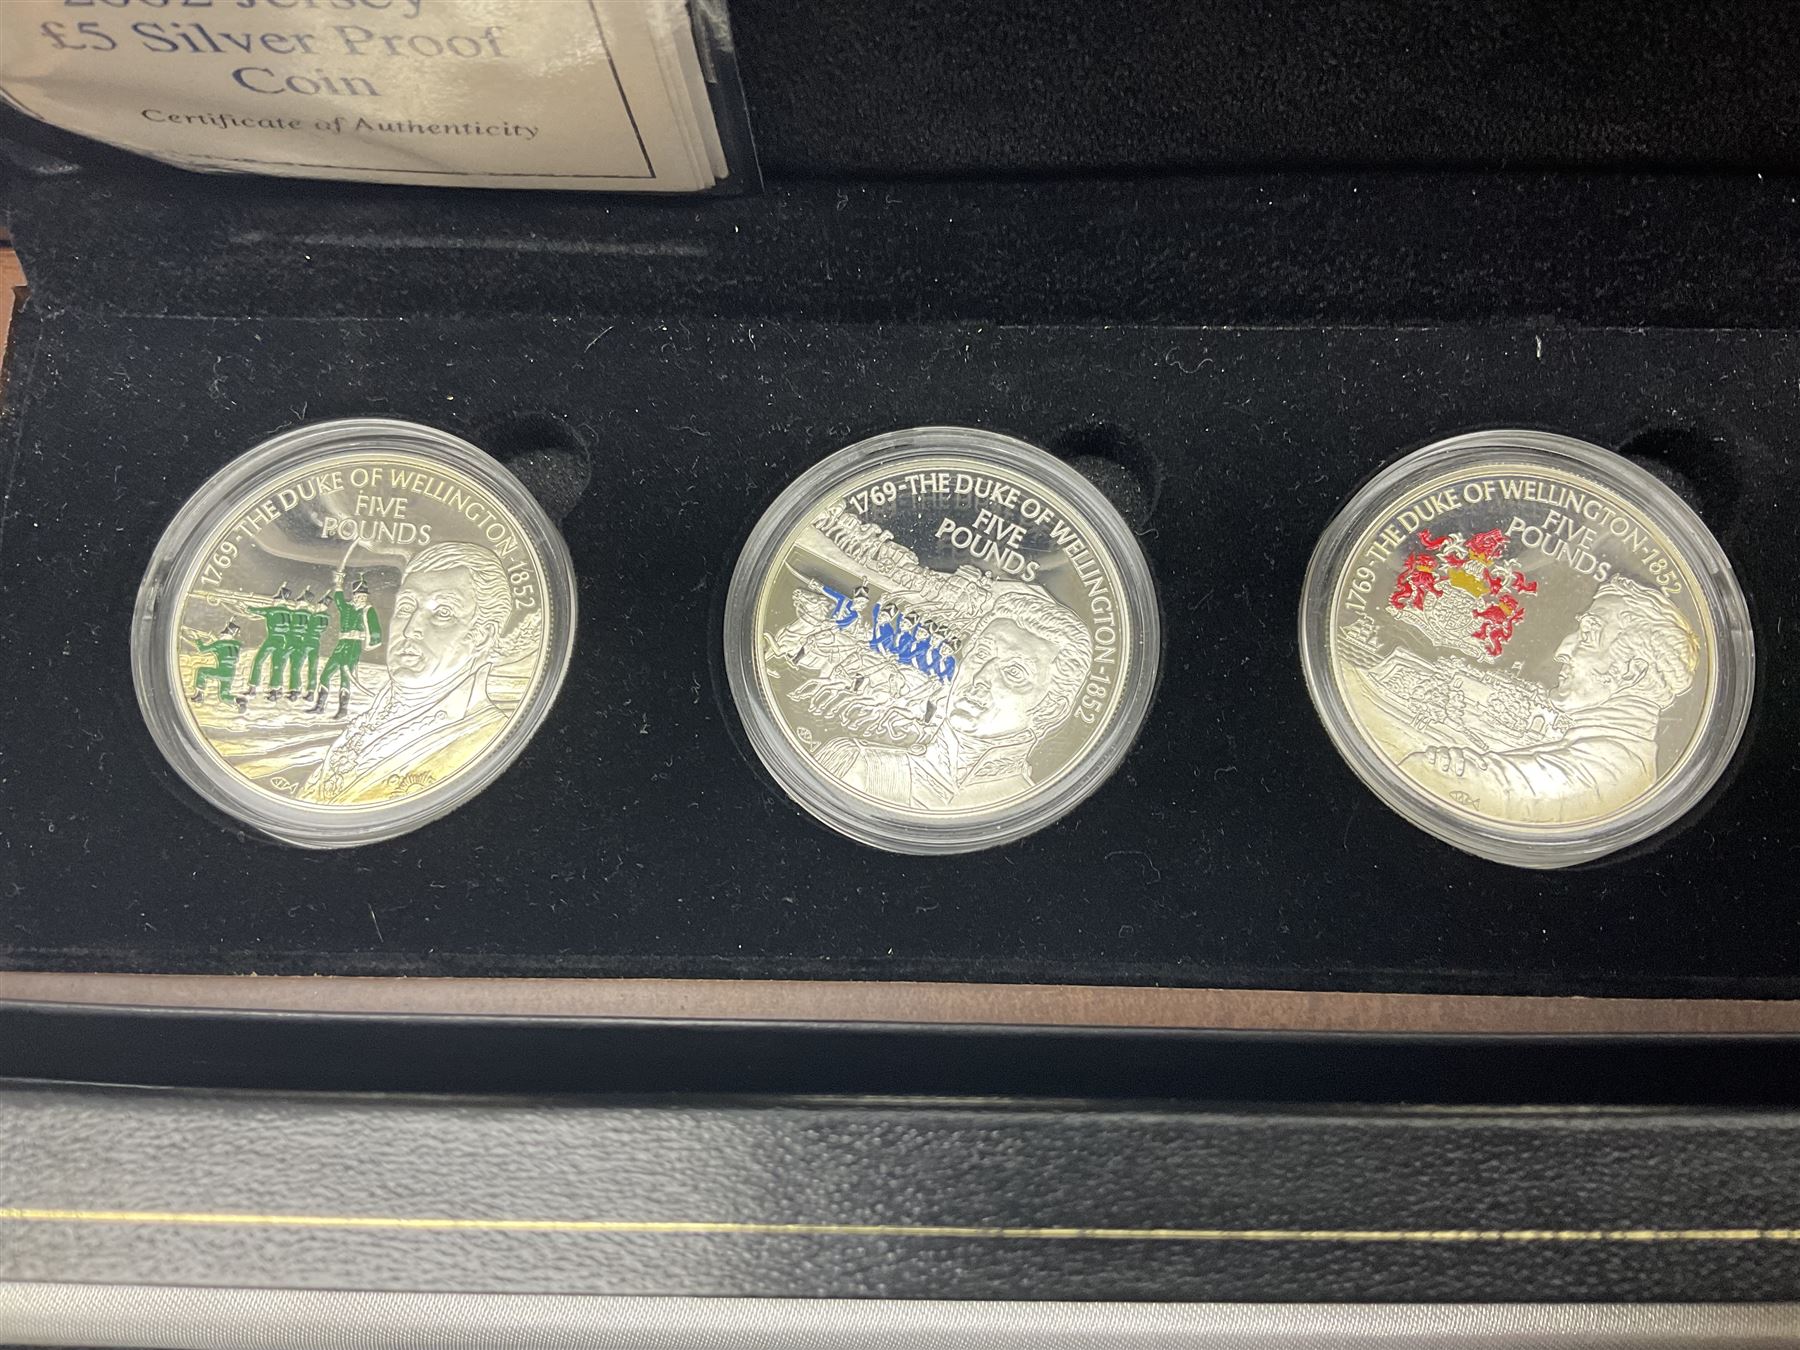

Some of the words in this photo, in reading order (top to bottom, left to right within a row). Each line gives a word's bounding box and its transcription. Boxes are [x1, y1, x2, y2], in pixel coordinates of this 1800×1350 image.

[40, 21, 118, 50] £5
[131, 22, 318, 54] Silver
[332, 25, 509, 58] Proof
[232, 67, 381, 96] Coin
[141, 109, 300, 130] Certificate
[315, 117, 346, 133] of
[355, 117, 538, 139] Authenticity
[277, 471, 344, 512] DUKE
[350, 468, 383, 488] OF
[355, 495, 408, 519] FIVE
[954, 474, 1021, 509] DUKE
[1021, 499, 1055, 526] OF
[1397, 488, 1462, 533] DUKE
[1464, 480, 1495, 503] OF
[321, 517, 432, 545] POUNDS
[972, 508, 1027, 549] FIVE
[1542, 509, 1597, 549] FIVE
[935, 518, 1040, 582] POUNDS
[1505, 516, 1611, 582] POUNDS
